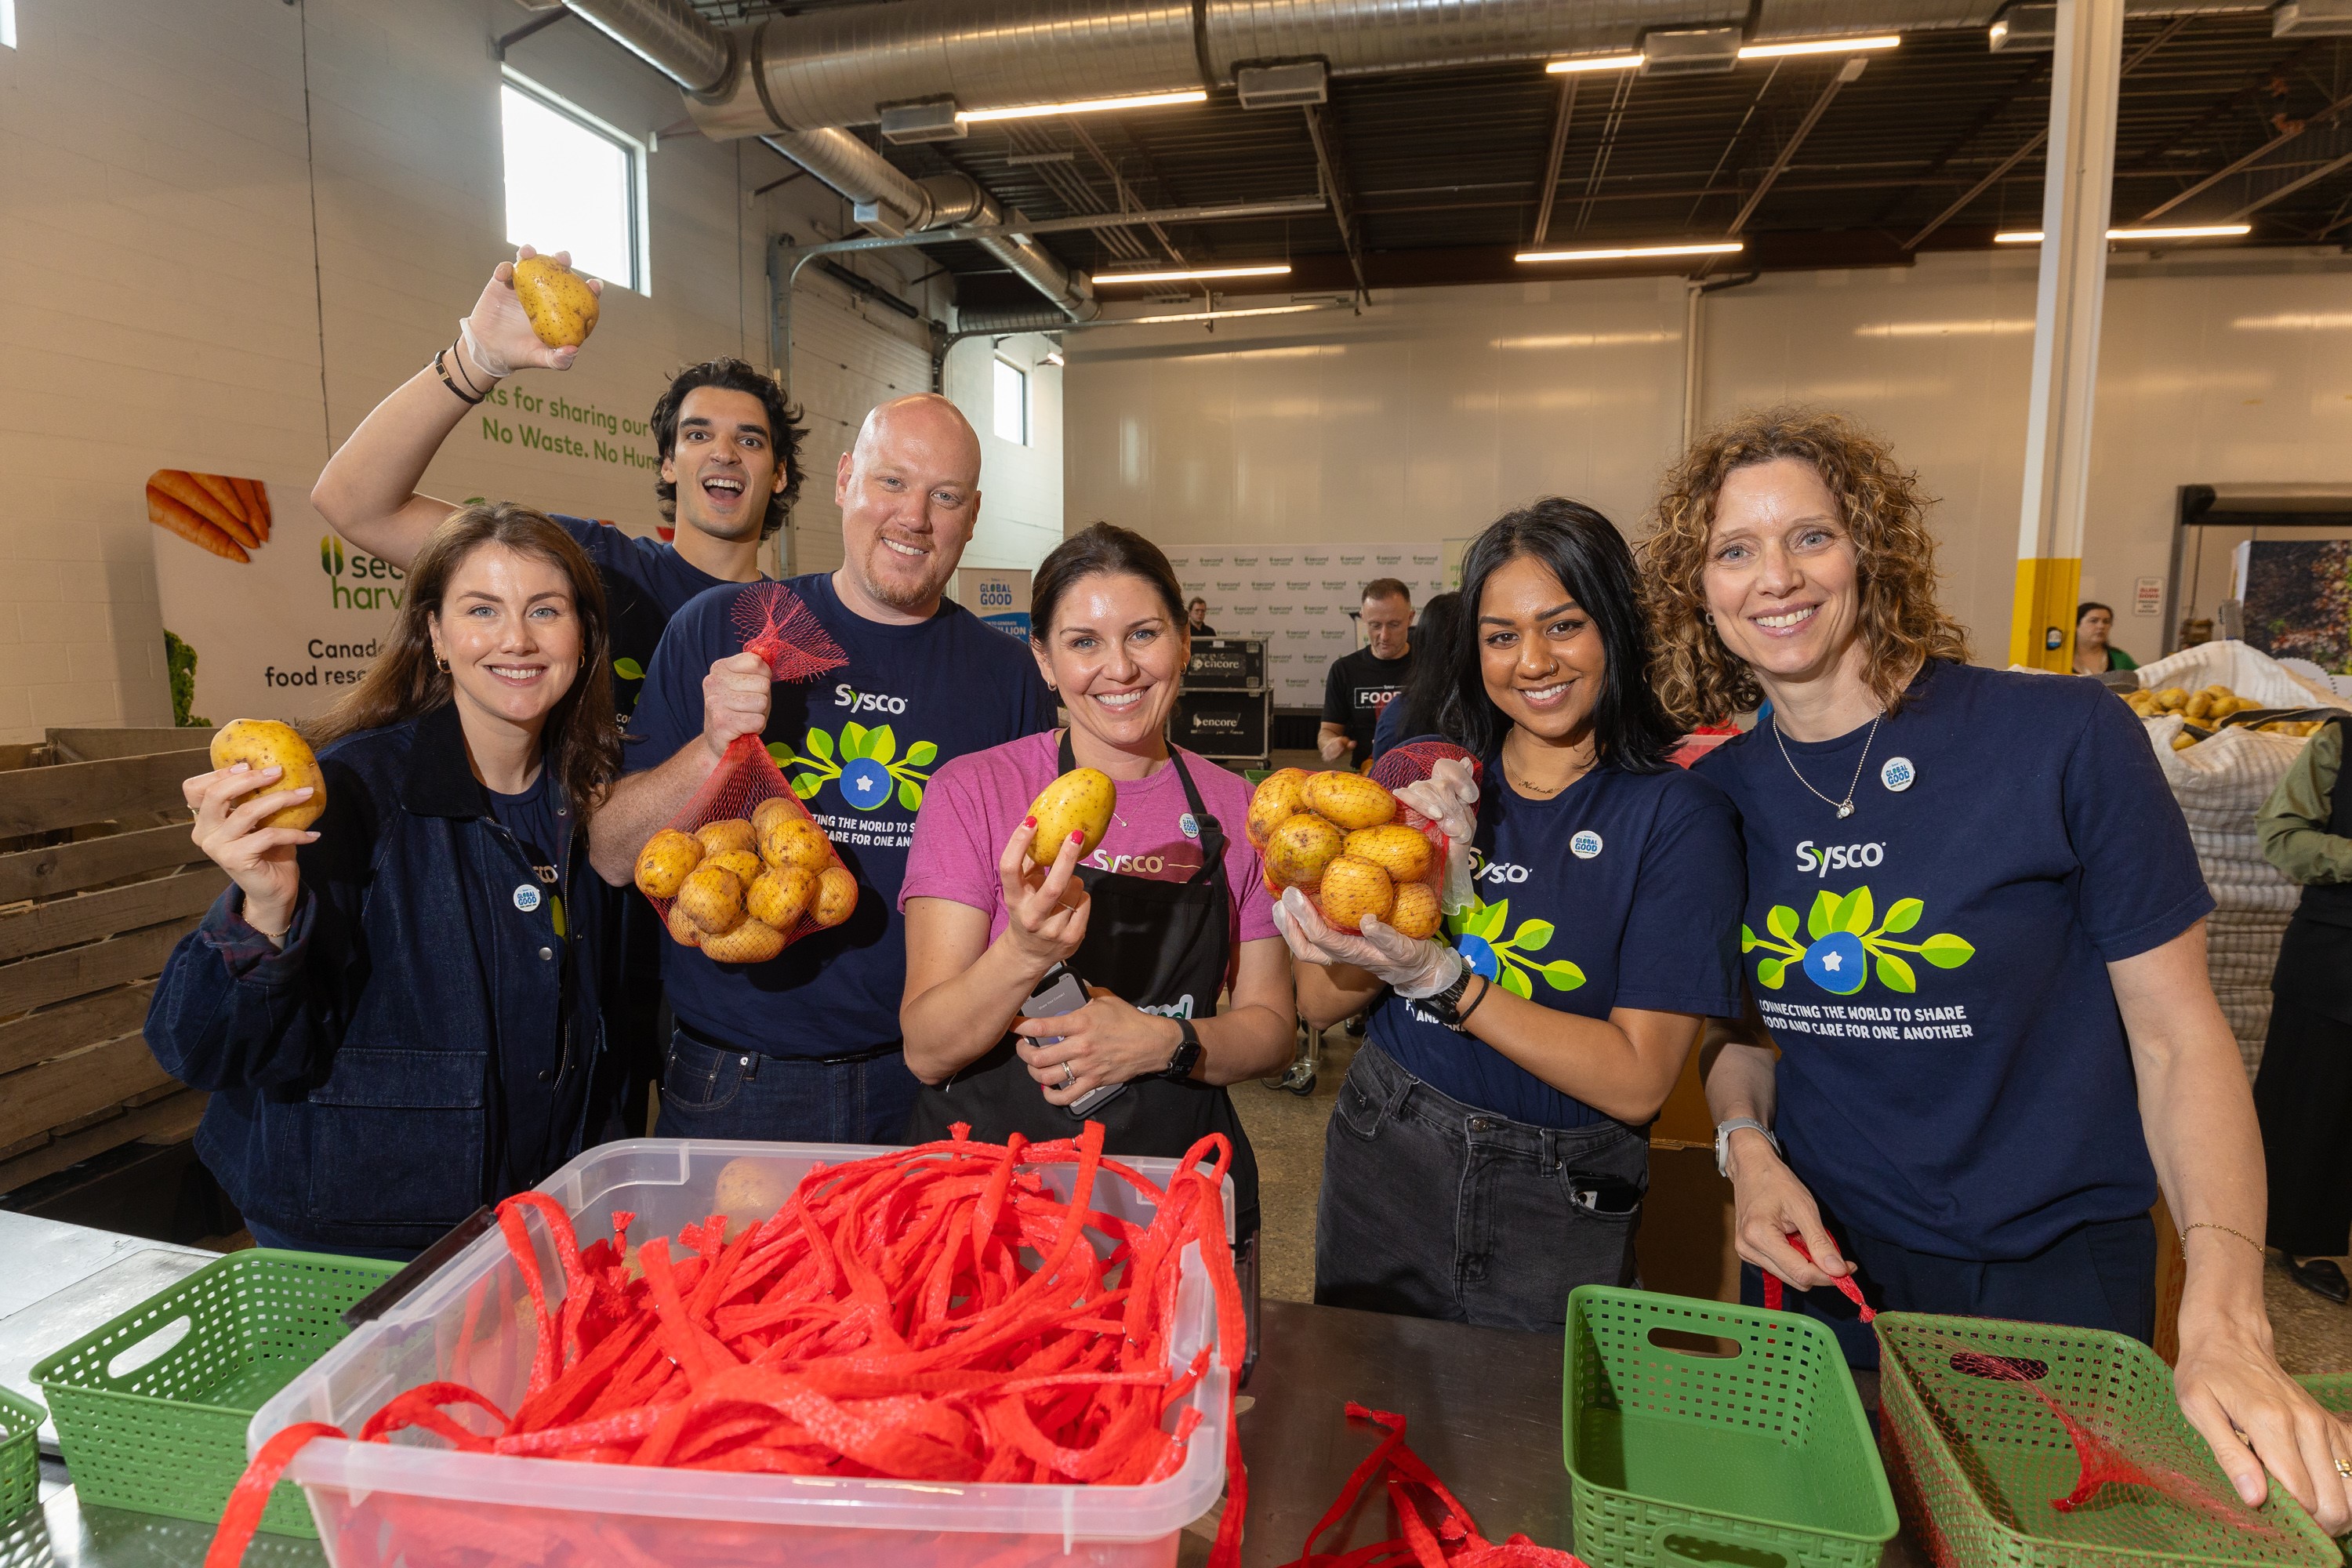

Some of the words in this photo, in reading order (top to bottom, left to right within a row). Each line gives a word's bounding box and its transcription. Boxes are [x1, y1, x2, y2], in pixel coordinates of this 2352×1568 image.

[514, 386, 543, 413] for
[550, 397, 617, 435] sharing
[622, 418, 648, 437] our
[482, 417, 513, 444] No
[519, 423, 589, 458] Waste.
[594, 439, 618, 463] No
[623, 445, 656, 470] Hun
[351, 556, 404, 580] sec
[332, 575, 404, 609] harv
[980, 584, 1011, 593] GLOBAL
[980, 593, 1012, 605] GOOD
[1204, 660, 1240, 669] encore
[265, 666, 318, 687] food
[325, 669, 366, 685] resc
[834, 684, 906, 714] Sysco
[1203, 718, 1237, 727] encore
[1886, 764, 1908, 777] GLOBAL
[1888, 771, 1910, 785] GOOD
[838, 817, 858, 829] THE
[859, 820, 895, 833] WORLD
[896, 822, 908, 833] TO
[824, 829, 849, 843] ARE
[851, 833, 871, 845] FOR
[873, 836, 894, 847] ONE
[1575, 843, 1597, 852] GOOD
[1093, 848, 1163, 873] Sysco
[1796, 840, 1885, 877] Sysco
[518, 896, 537, 906] GOOD
[1759, 999, 1821, 1018] CONNECTING
[1821, 1006, 1847, 1019] THE
[1847, 1006, 1892, 1021] WORLD
[1893, 1008, 1911, 1022] TO
[1914, 1005, 1967, 1022] SHARE
[1762, 1014, 1788, 1029] FOOD
[1788, 1019, 1811, 1033] AND
[1812, 1023, 1845, 1036] CARE
[1846, 1024, 1871, 1039] FOR
[1872, 1025, 1900, 1040] ONE
[1904, 1024, 1974, 1040] ANOTHER
